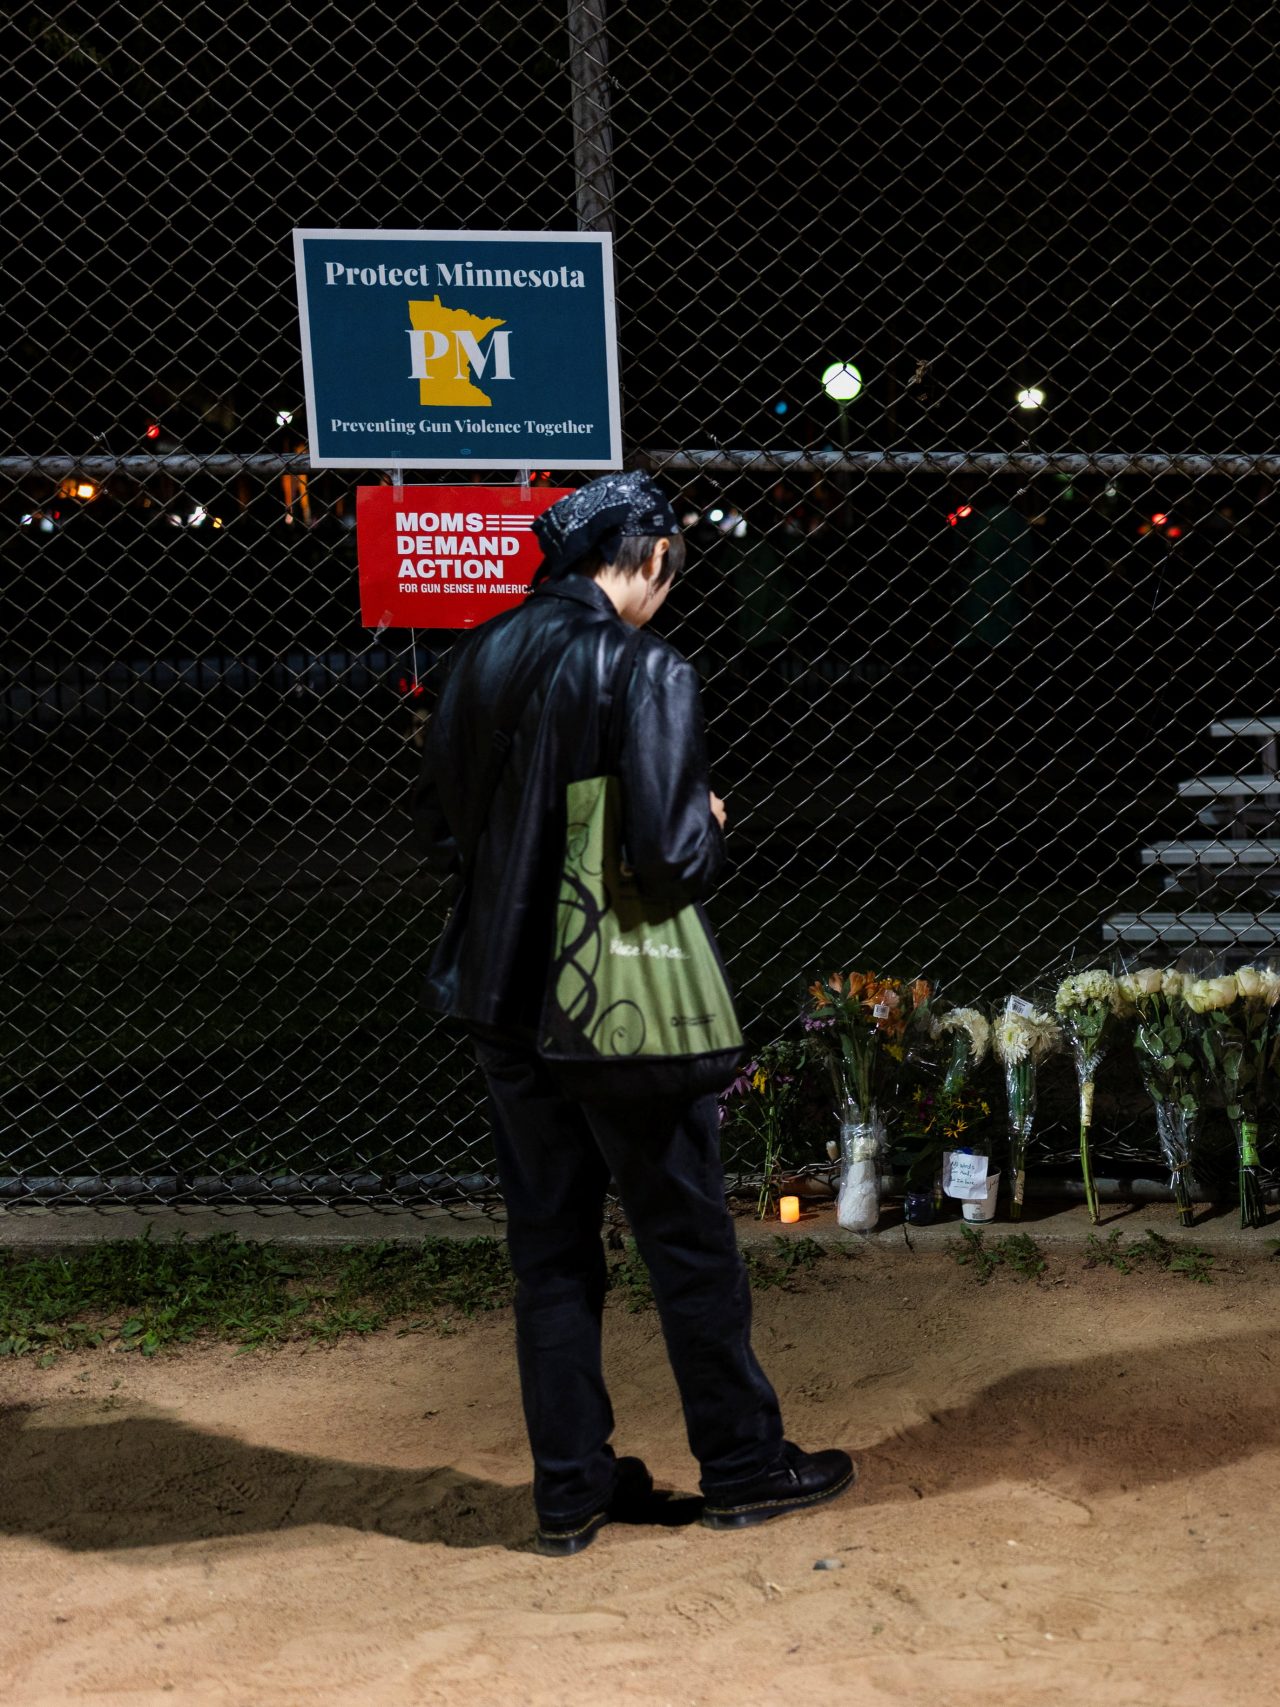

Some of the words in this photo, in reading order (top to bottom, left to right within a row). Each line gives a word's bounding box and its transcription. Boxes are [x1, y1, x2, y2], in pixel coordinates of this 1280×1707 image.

[325, 262, 430, 287] Protect
[436, 261, 586, 288] Minnesota
[405, 329, 515, 380] PM
[331, 418, 416, 436] Preventing
[418, 419, 452, 433] Gun
[454, 418, 521, 434] Violence
[524, 419, 594, 436] Together
[395, 511, 484, 533] MOMS
[396, 535, 520, 556] DEMAND
[397, 558, 504, 579] ACTION
[398, 582, 419, 594] FOR
[420, 583, 442, 594] GUN
[443, 583, 475, 594] SENSE
[476, 583, 487, 594] IN
[488, 583, 531, 595] AMERIC
